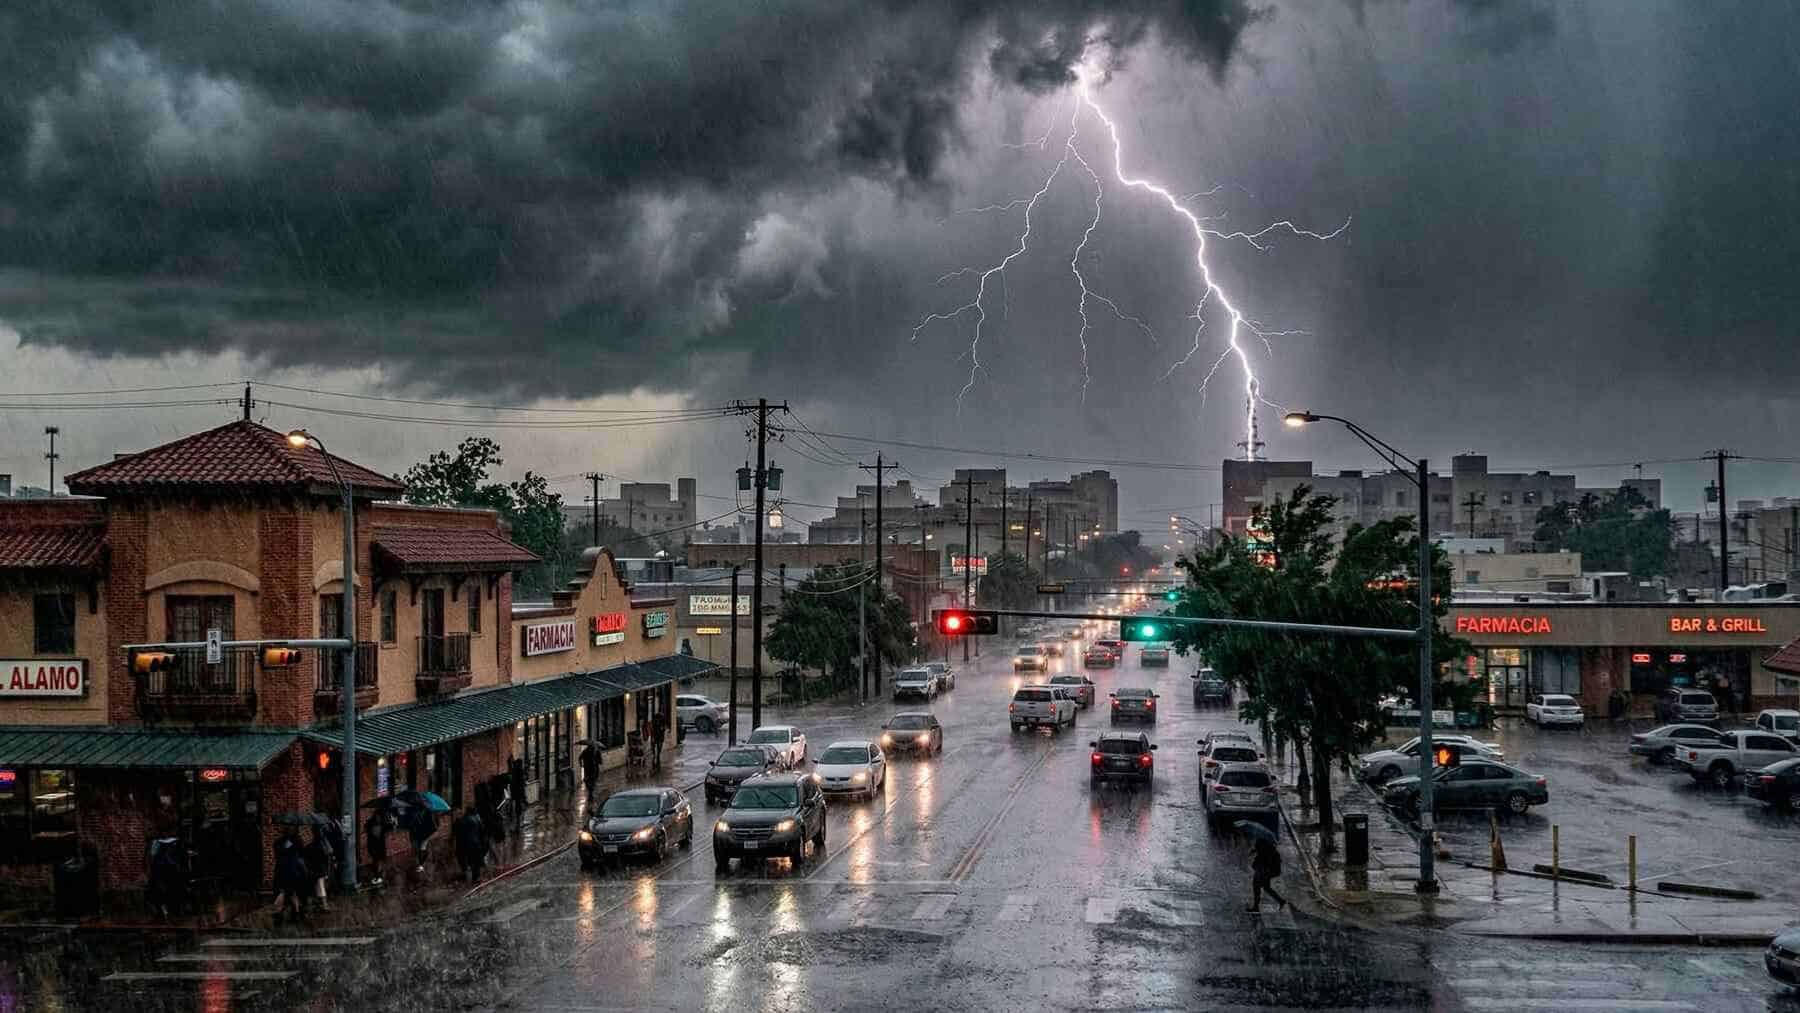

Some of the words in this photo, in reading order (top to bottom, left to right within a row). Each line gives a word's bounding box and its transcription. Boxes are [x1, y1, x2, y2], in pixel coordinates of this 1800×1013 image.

[1457, 616, 1551, 633] FARMACIA
[1671, 618, 1702, 632] BAR
[1706, 618, 1717, 632] &
[1722, 618, 1767, 632] GRILL
[528, 624, 575, 653] FARMACIA
[10, 666, 79, 690] ALAMO
